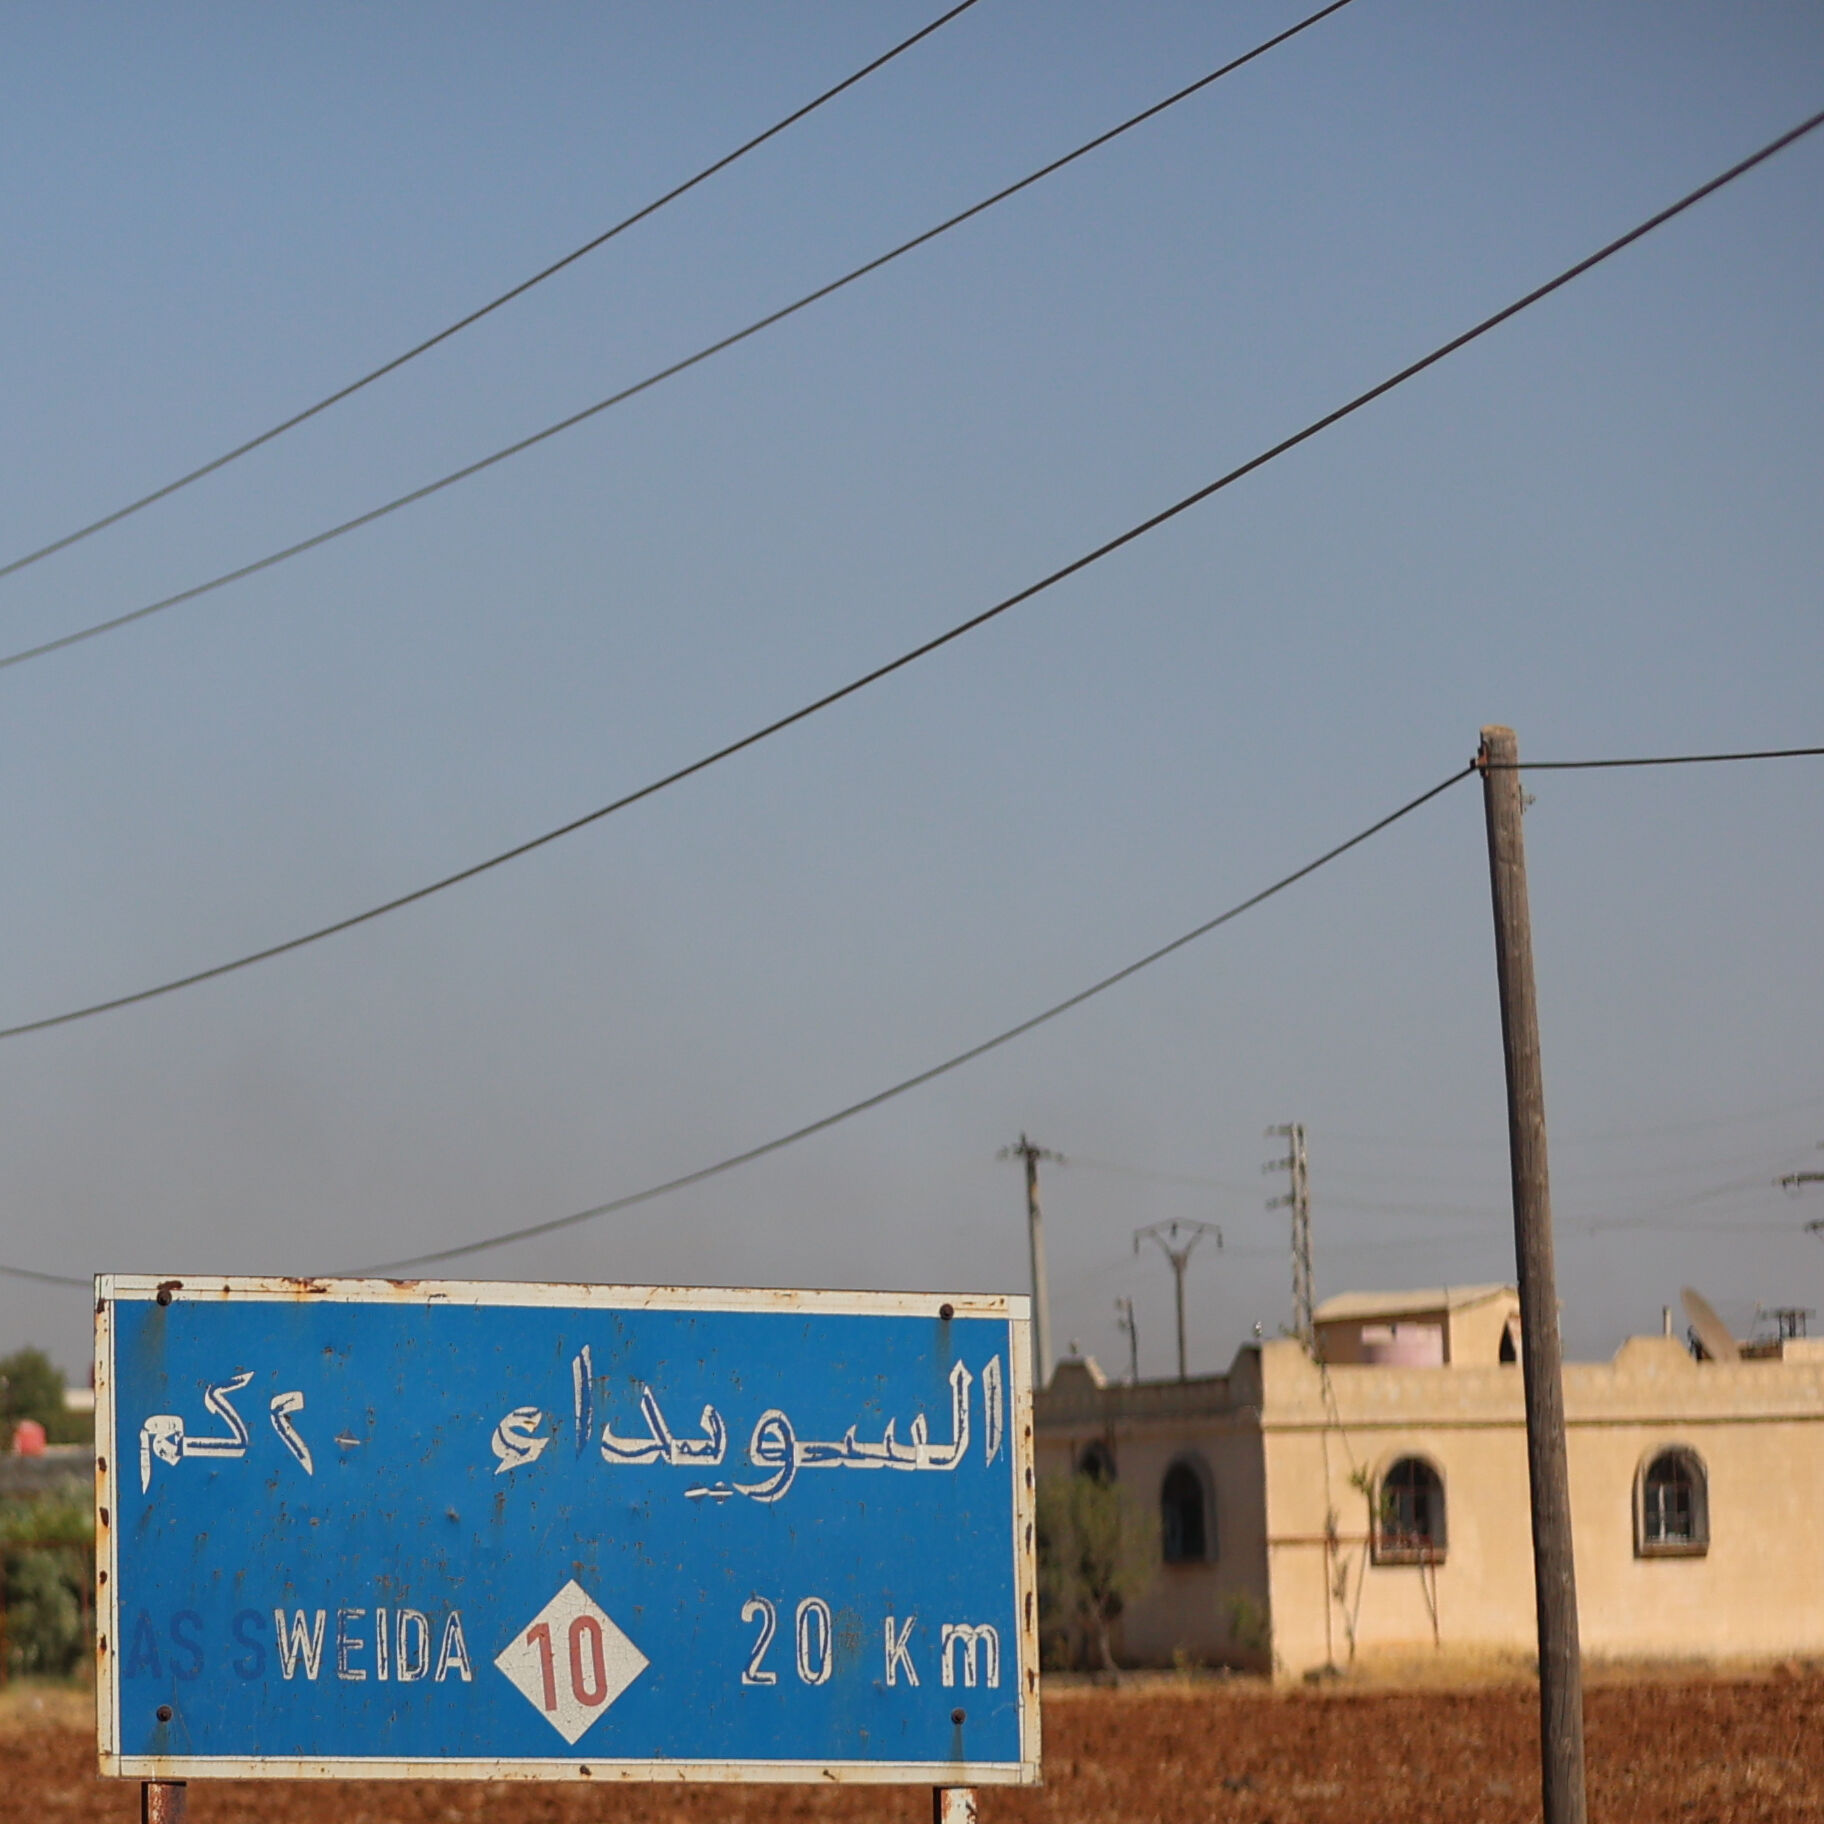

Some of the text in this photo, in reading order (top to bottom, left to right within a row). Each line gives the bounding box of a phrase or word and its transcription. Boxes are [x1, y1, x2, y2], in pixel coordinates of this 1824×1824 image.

[491, 1343, 1005, 1503] السويداء
[525, 1614, 609, 1713] 10
[740, 1596, 833, 1687] 20
